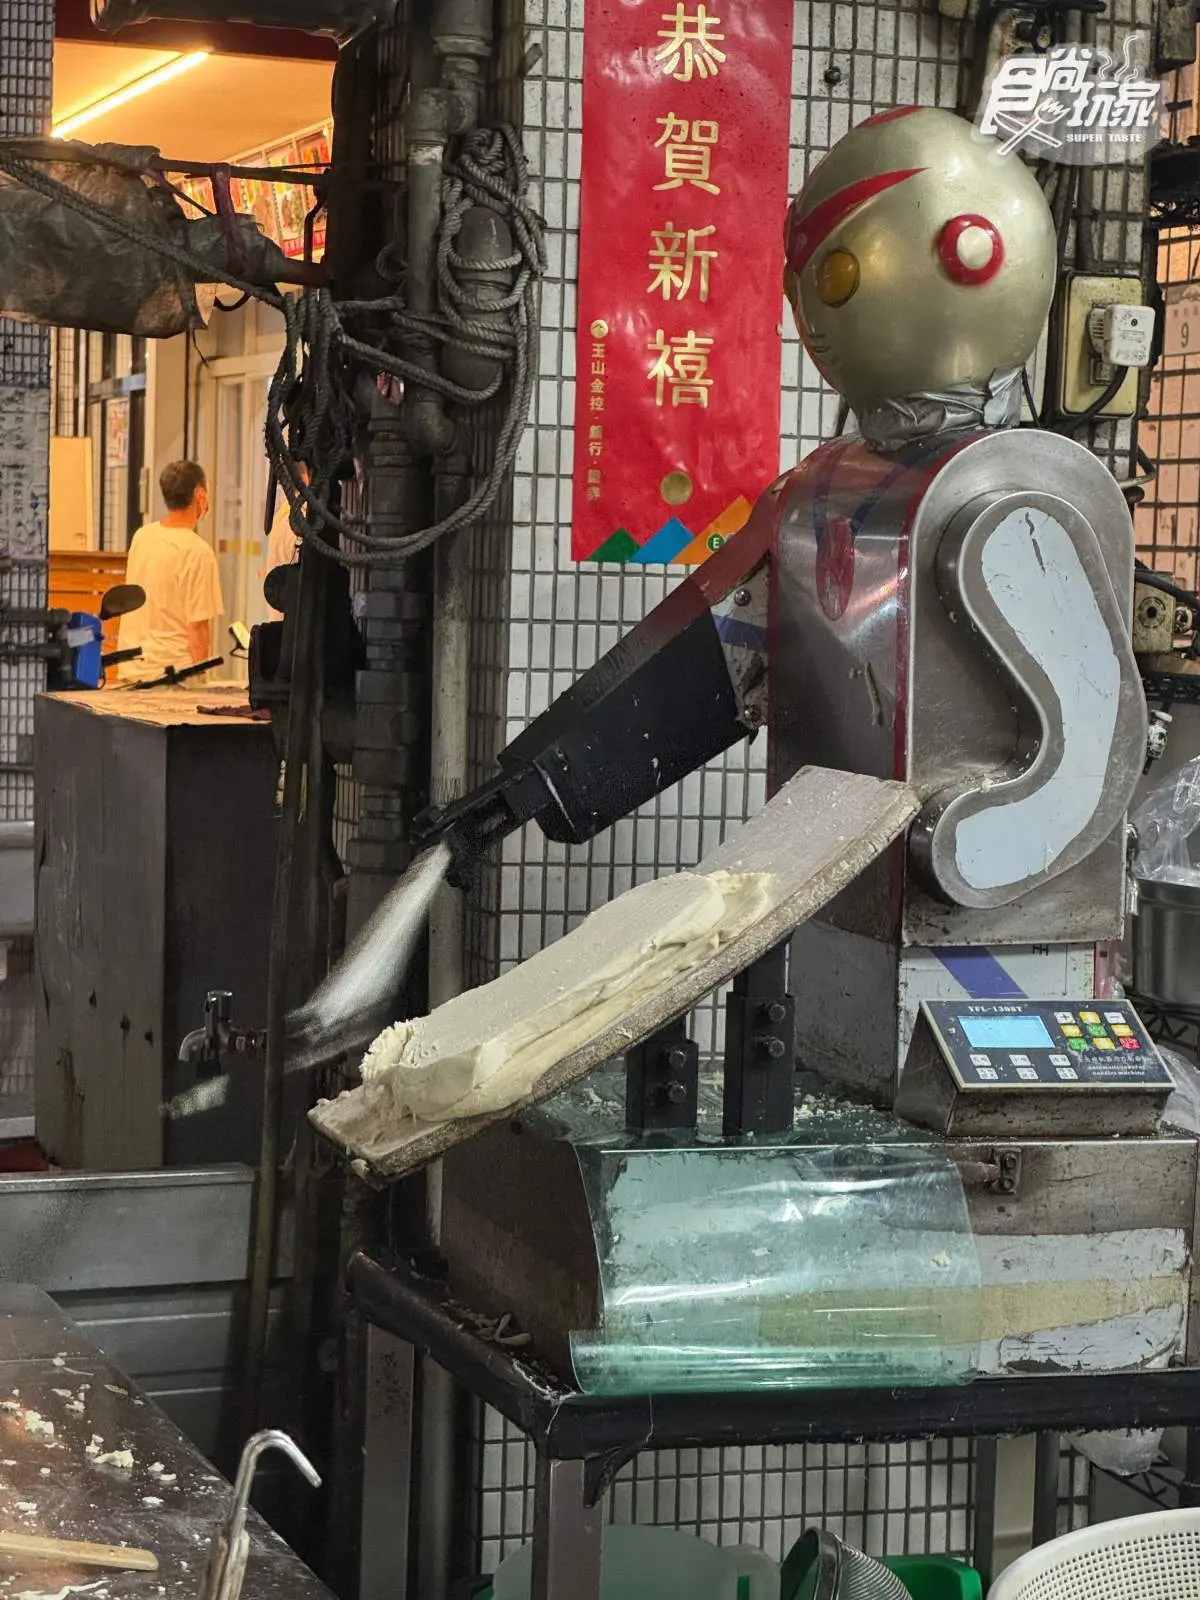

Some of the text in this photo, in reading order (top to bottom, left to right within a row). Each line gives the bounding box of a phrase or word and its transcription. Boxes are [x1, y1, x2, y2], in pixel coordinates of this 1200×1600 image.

[646, 2, 727, 408] 恭賀新禧
[1180, 321, 1190, 348] 9
